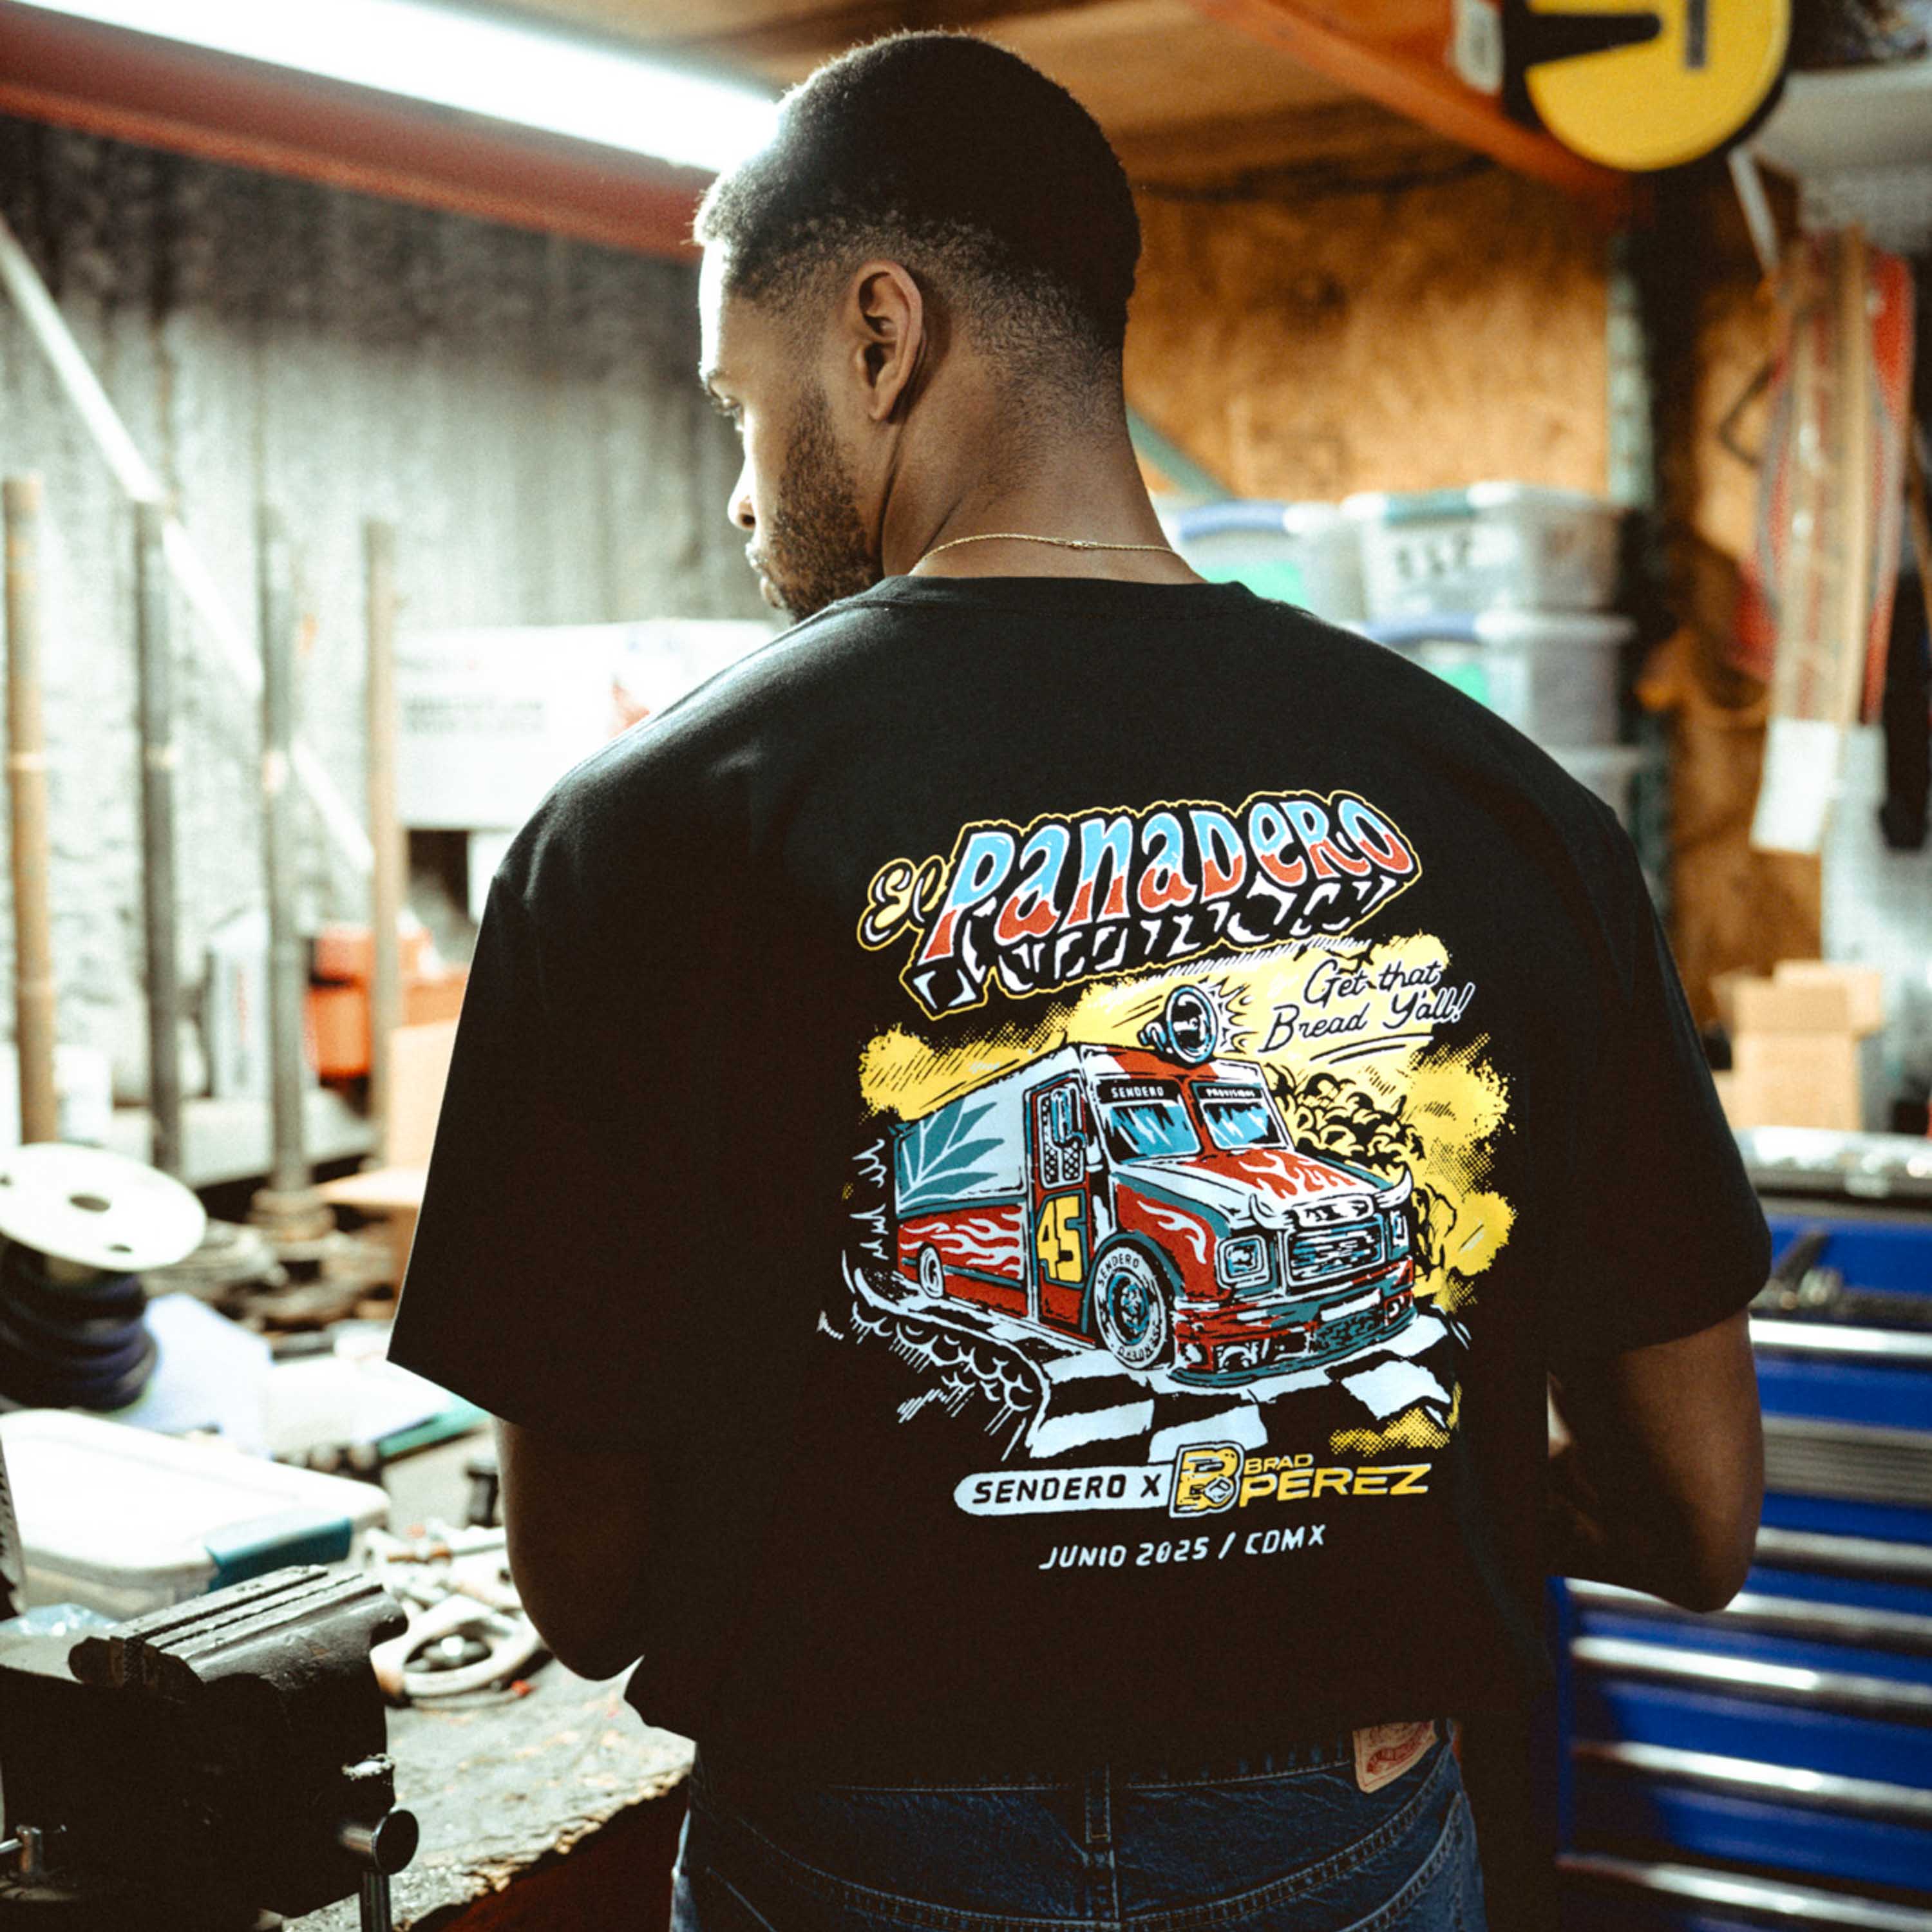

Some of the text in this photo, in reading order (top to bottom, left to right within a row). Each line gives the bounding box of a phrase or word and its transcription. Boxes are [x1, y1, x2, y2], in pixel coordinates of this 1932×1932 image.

[859, 857, 945, 949] El
[1303, 958, 1441, 1008] Get that
[1258, 983, 1475, 1053] Bread Y'all!
[1110, 1085, 1164, 1099] SENDERO
[1037, 1195, 1083, 1283] 45
[1097, 1253, 1139, 1287] SENDERO
[1239, 1464, 1432, 1508] PEREZ
[1244, 1454, 1314, 1475] BRAD
[972, 1473, 1161, 1504] SENDERO X
[1038, 1524, 1326, 1569] JUNIO 2025 / CDMX
